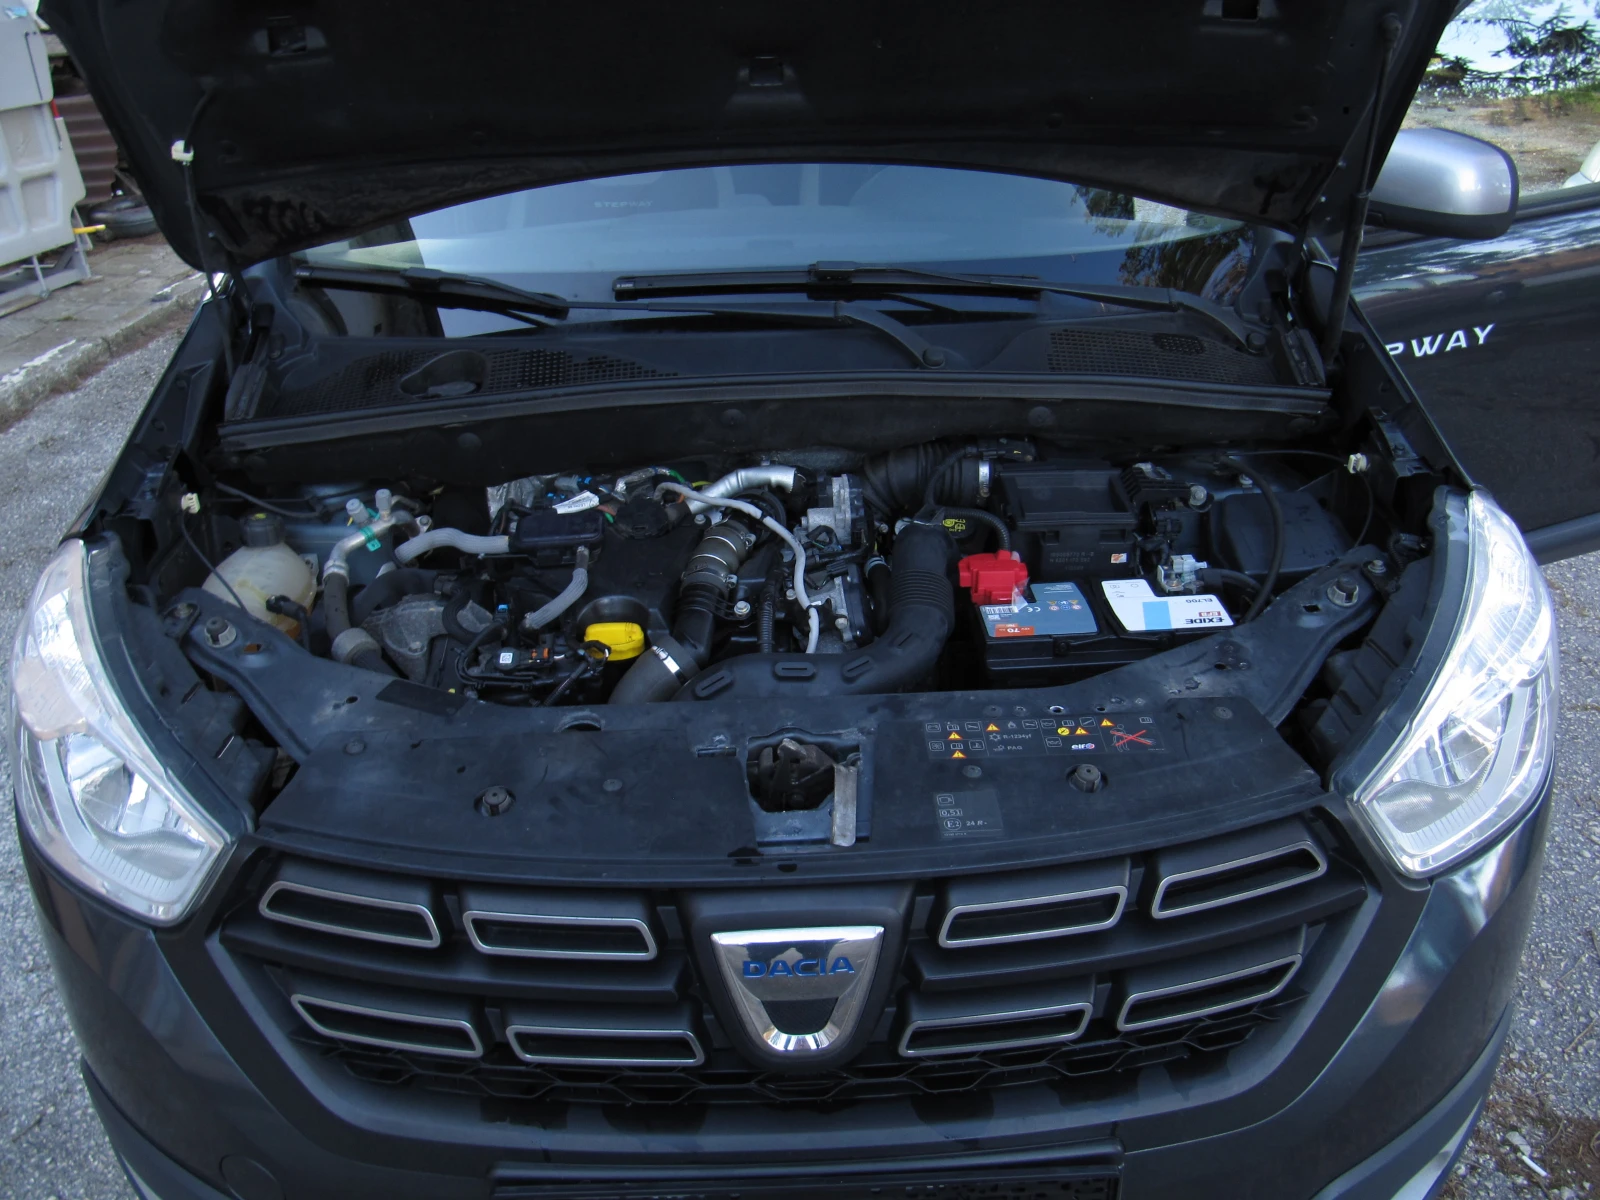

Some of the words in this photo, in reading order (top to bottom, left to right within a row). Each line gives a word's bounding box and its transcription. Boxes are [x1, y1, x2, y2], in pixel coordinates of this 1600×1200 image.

[593, 200, 653, 208] STEPWAY
[1185, 617, 1225, 625] EXIDE
[743, 956, 855, 978] DACIA
